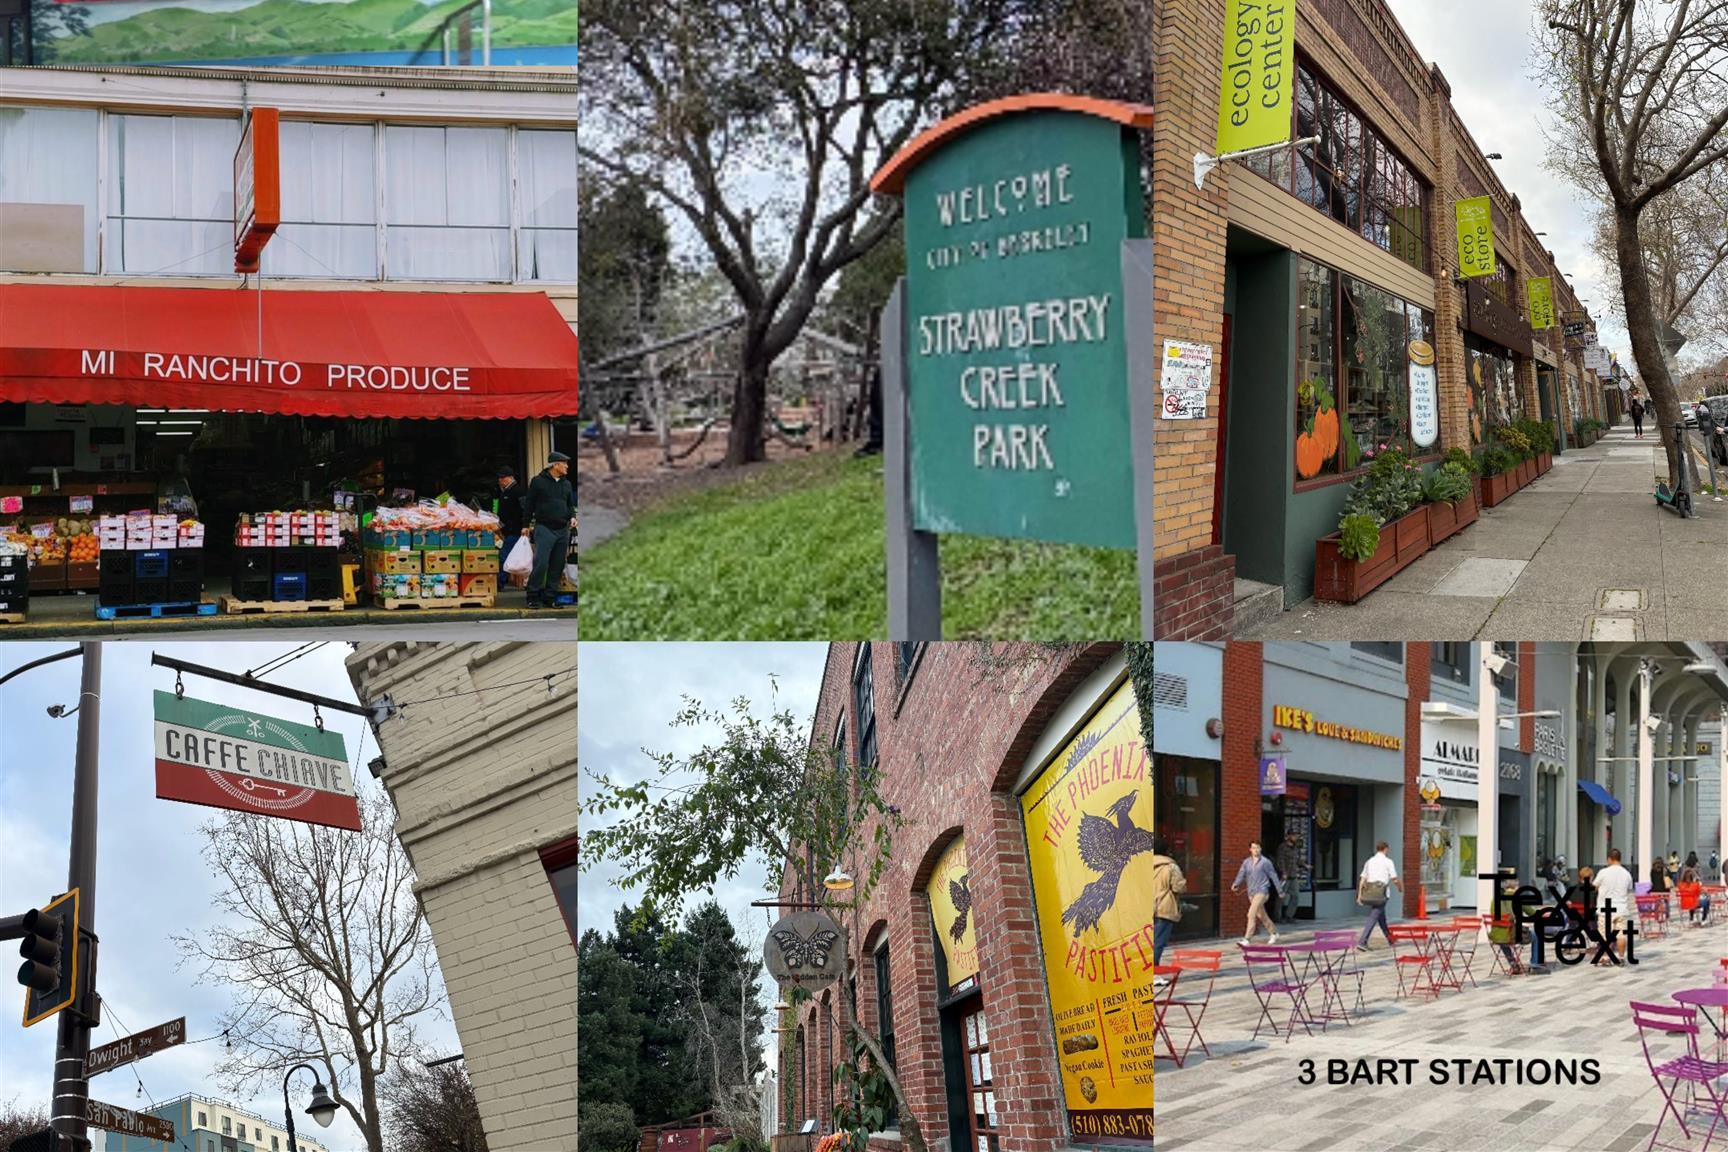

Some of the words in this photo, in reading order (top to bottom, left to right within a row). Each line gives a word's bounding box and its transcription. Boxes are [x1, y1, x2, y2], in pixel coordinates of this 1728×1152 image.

[1228, 0, 1262, 127] ecology
[1260, 3, 1285, 109] center
[936, 162, 1075, 228] WELCOME
[1464, 234, 1475, 265] eco
[1476, 225, 1491, 270] store
[919, 293, 1112, 356] STRAWBERRY
[80, 349, 115, 376] MI
[143, 352, 301, 385] RANCHITO
[327, 364, 471, 391] PRODUCE
[959, 362, 1064, 410] CREEK
[974, 423, 1054, 470] PARK
[1274, 704, 1314, 734] IKE'S
[1315, 720, 1340, 738] LOVE
[1340, 728, 1350, 740] &
[166, 729, 250, 773] CAFFE
[257, 749, 346, 792] CHIAVE
[1043, 800, 1072, 849] THE
[1102, 992, 1127, 1008] FRESH
[88, 1038, 133, 1068] Dwight
[163, 1021, 181, 1036] 1100
[1082, 1059, 1104, 1070] Cookie
[1071, 1115, 1101, 1137] (510)
